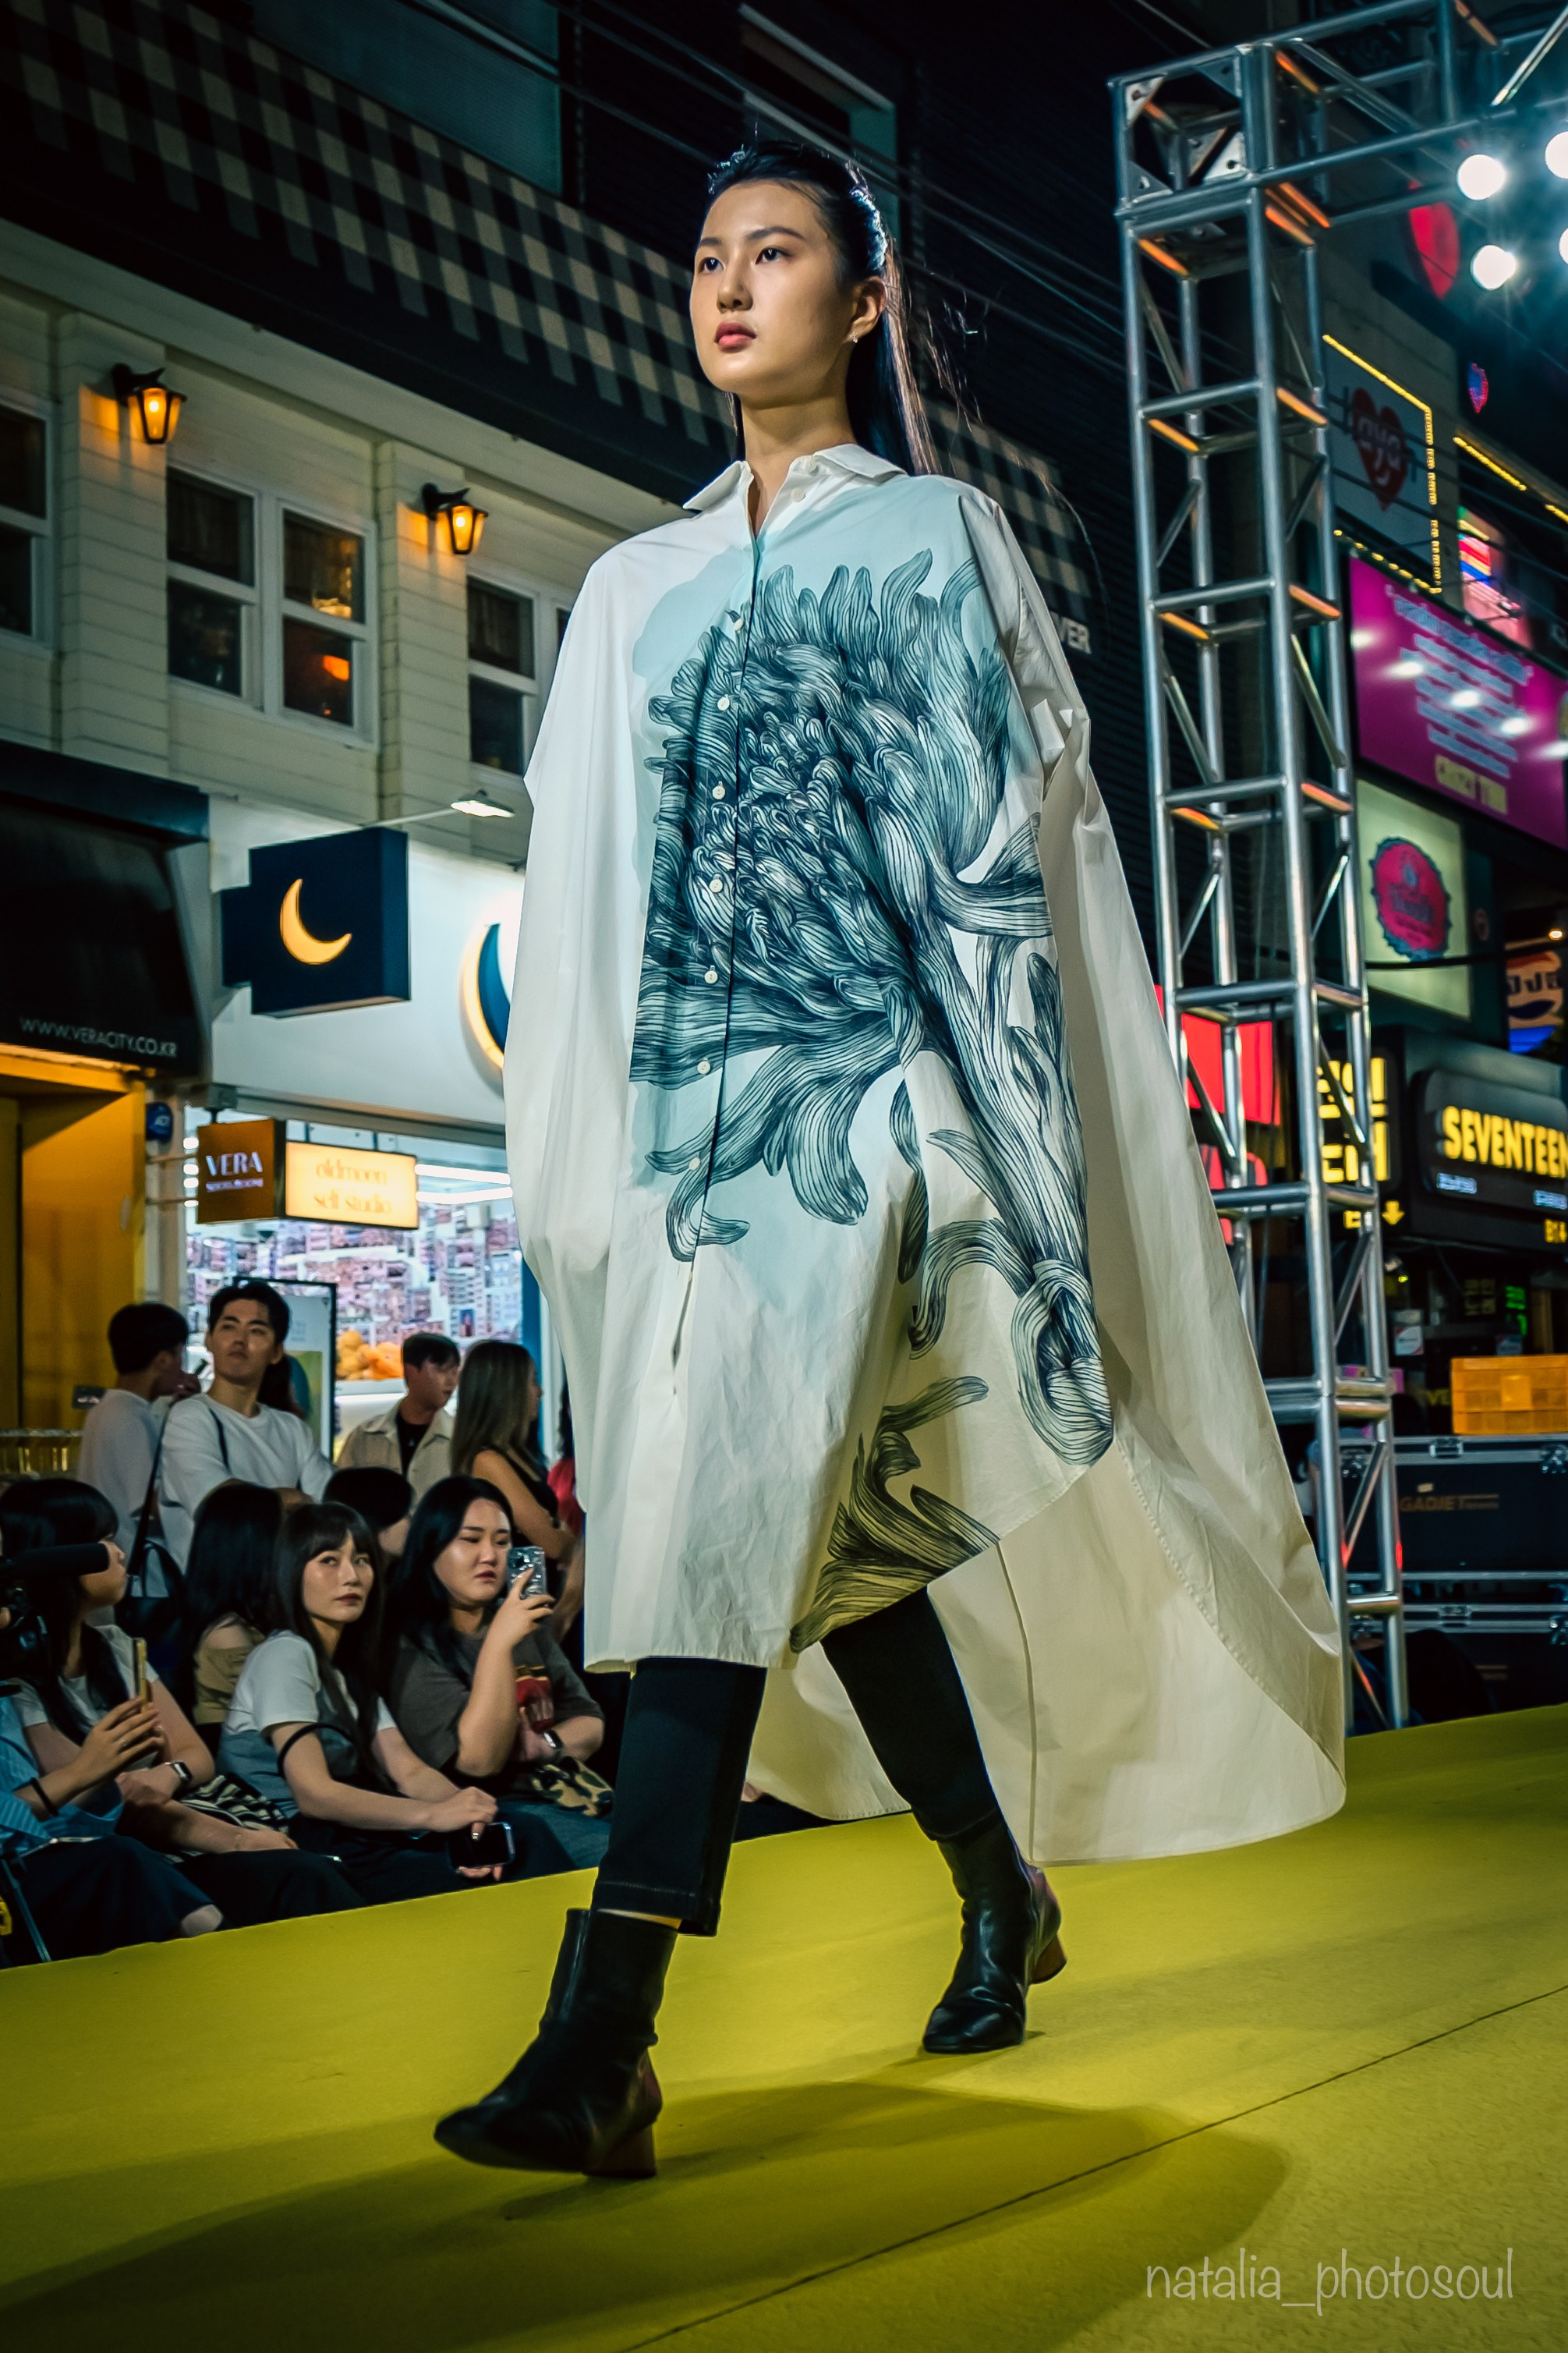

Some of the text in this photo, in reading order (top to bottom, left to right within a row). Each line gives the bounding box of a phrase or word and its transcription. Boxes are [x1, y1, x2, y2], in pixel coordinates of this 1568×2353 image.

[19, 1016, 178, 1058] WWW.VERACITY.CO.KR
[206, 1151, 263, 1176] VERA
[315, 1159, 387, 1185] oldmoon
[344, 1193, 393, 1214] studio
